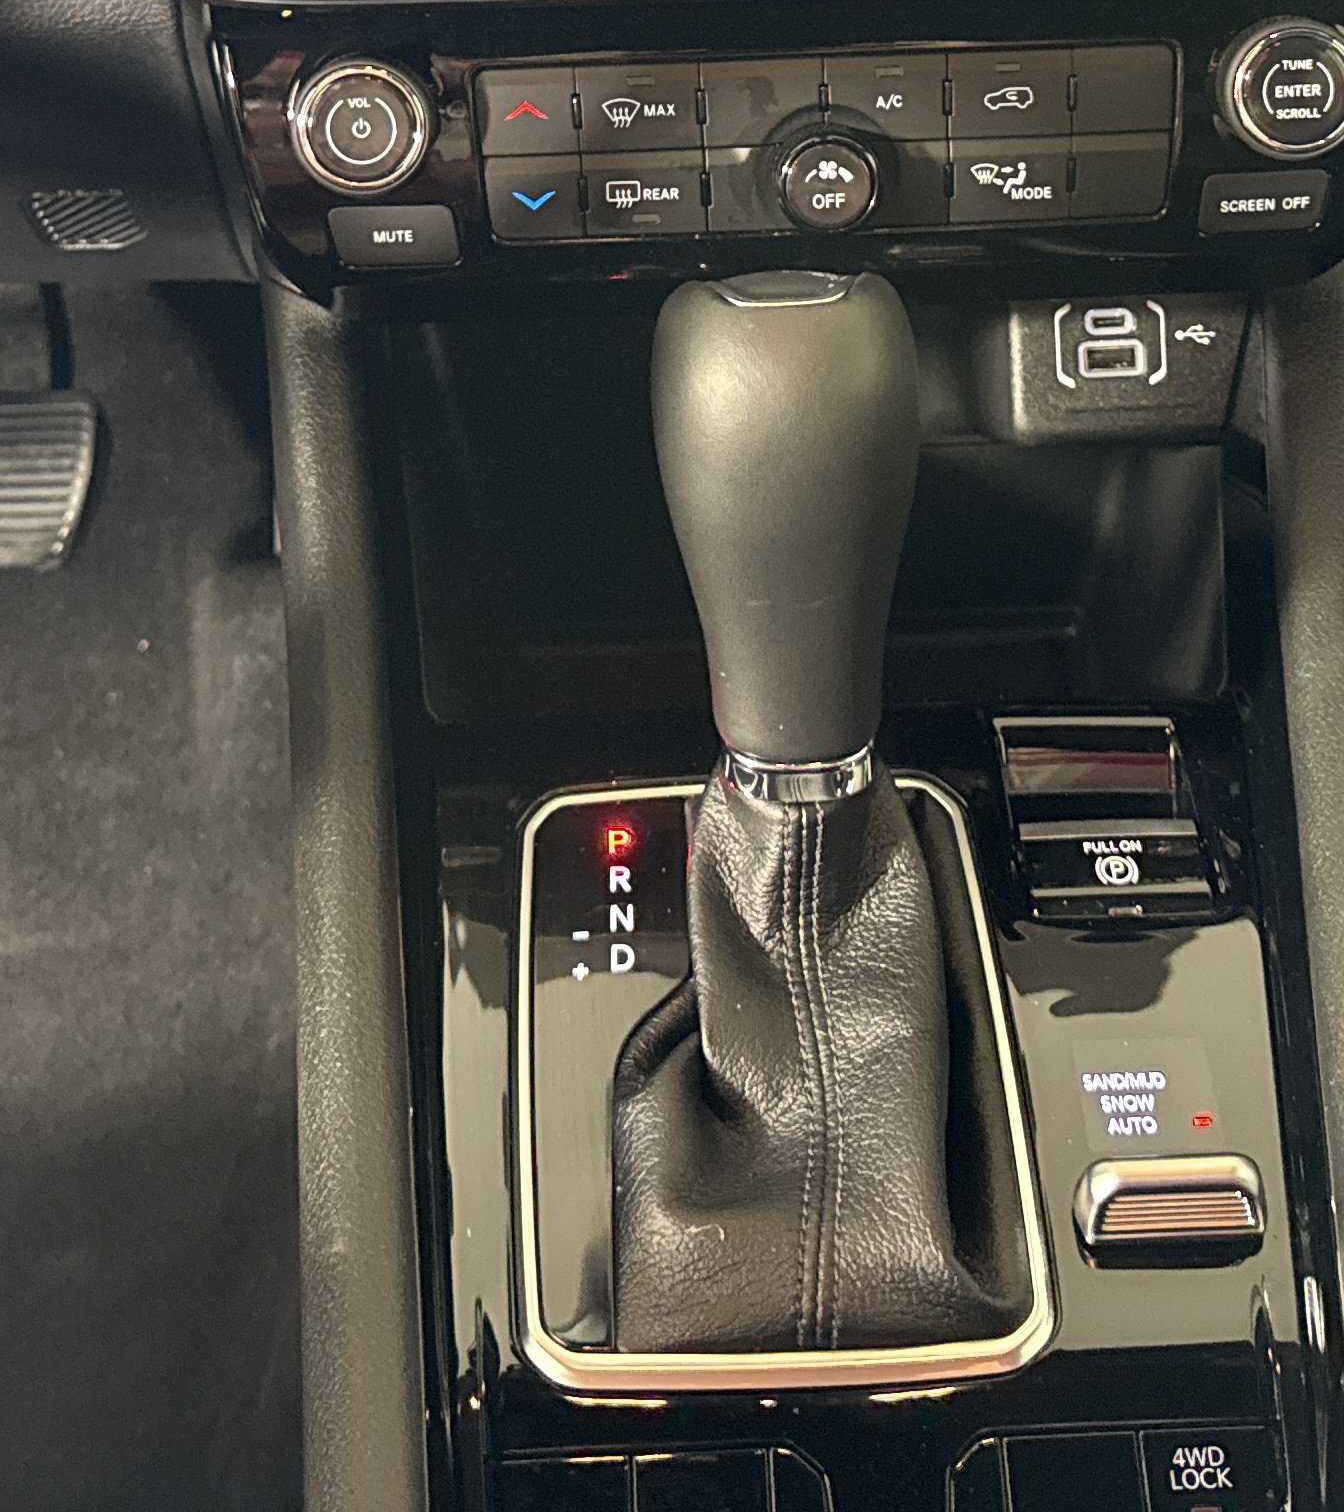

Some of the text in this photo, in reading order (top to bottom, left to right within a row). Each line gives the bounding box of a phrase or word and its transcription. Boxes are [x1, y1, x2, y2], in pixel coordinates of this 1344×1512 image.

[1282, 59, 1314, 71] TUNE
[1274, 83, 1322, 99] ENTER
[347, 97, 371, 110] VOL
[643, 102, 676, 118] MAX
[875, 93, 904, 110] A/C
[1276, 107, 1322, 121] SCROLL
[642, 186, 680, 202] REAR
[812, 192, 846, 210] OFF
[1011, 186, 1052, 201] MODE
[1219, 195, 1311, 213] SCREEN OFF
[373, 228, 414, 244] MUTE
[607, 829, 631, 855] P
[1083, 839, 1143, 855] PULL ON
[609, 865, 632, 893] R
[609, 903, 634, 933] N
[610, 943, 635, 974] D
[1082, 1070, 1167, 1092] SAND/MUD
[1100, 1093, 1155, 1115] SNOW
[1107, 1115, 1158, 1136] AUTO
[1172, 1445, 1225, 1468] 4WD
[1169, 1467, 1234, 1490] LOCK
